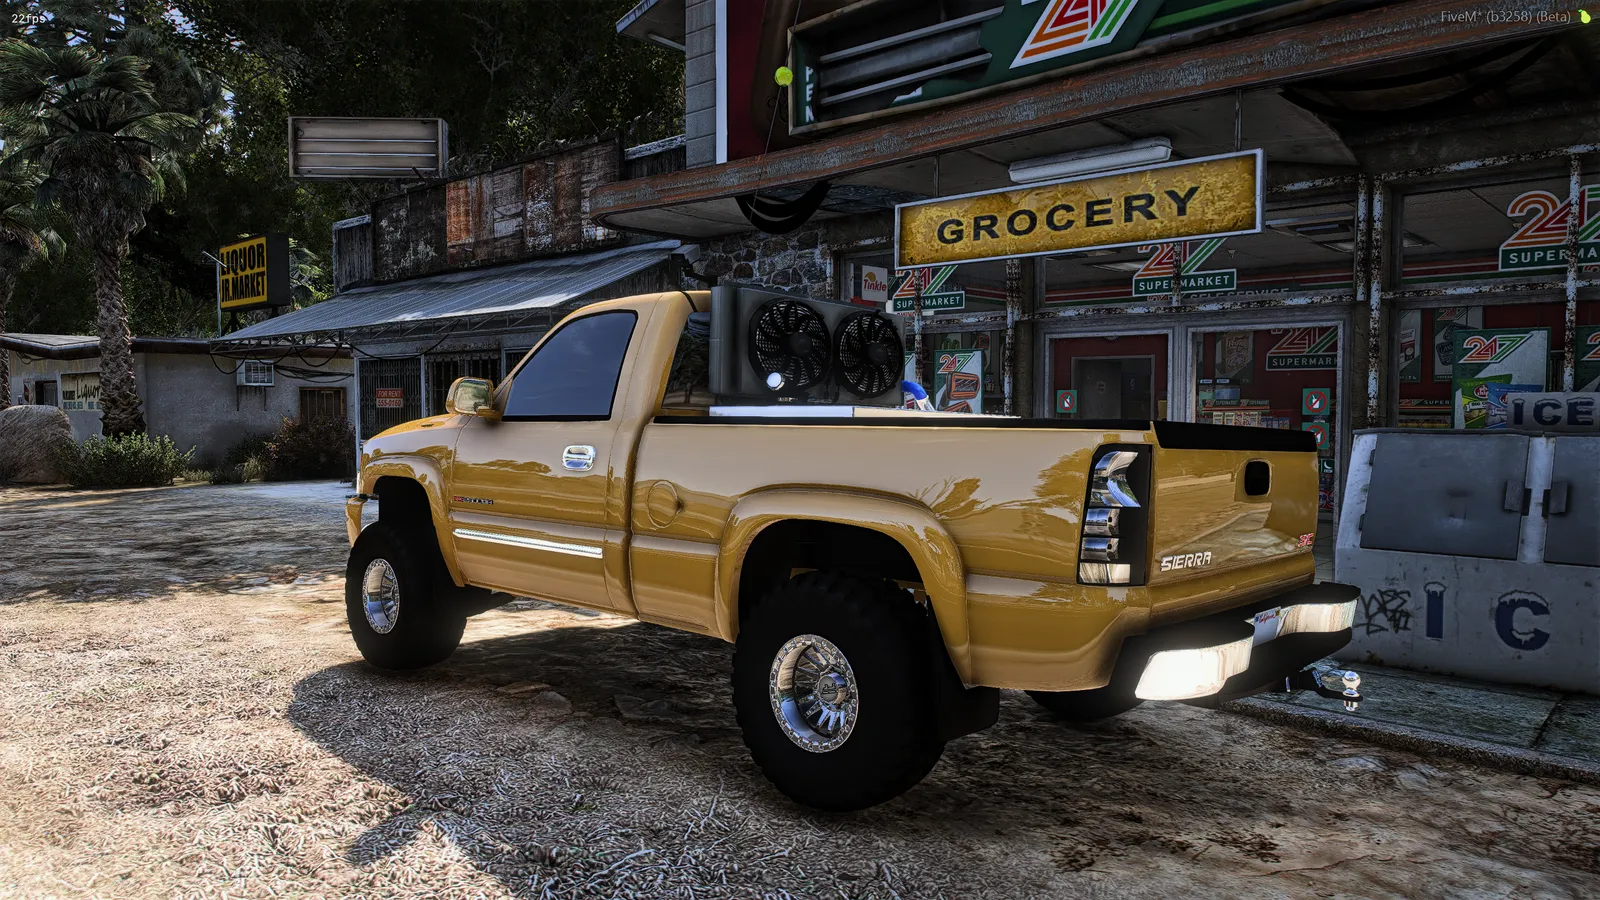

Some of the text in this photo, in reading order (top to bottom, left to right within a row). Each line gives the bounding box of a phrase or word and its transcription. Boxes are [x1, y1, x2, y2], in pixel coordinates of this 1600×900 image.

[937, 186, 1200, 245] GROCERY
[221, 243, 265, 276] LIQUOR
[863, 278, 887, 292] Tinkle
[1138, 275, 1230, 291] SUPEMARKET
[1458, 333, 1533, 364] 247
[1512, 397, 1595, 426] ICE
[1161, 551, 1212, 571] SIERRA
